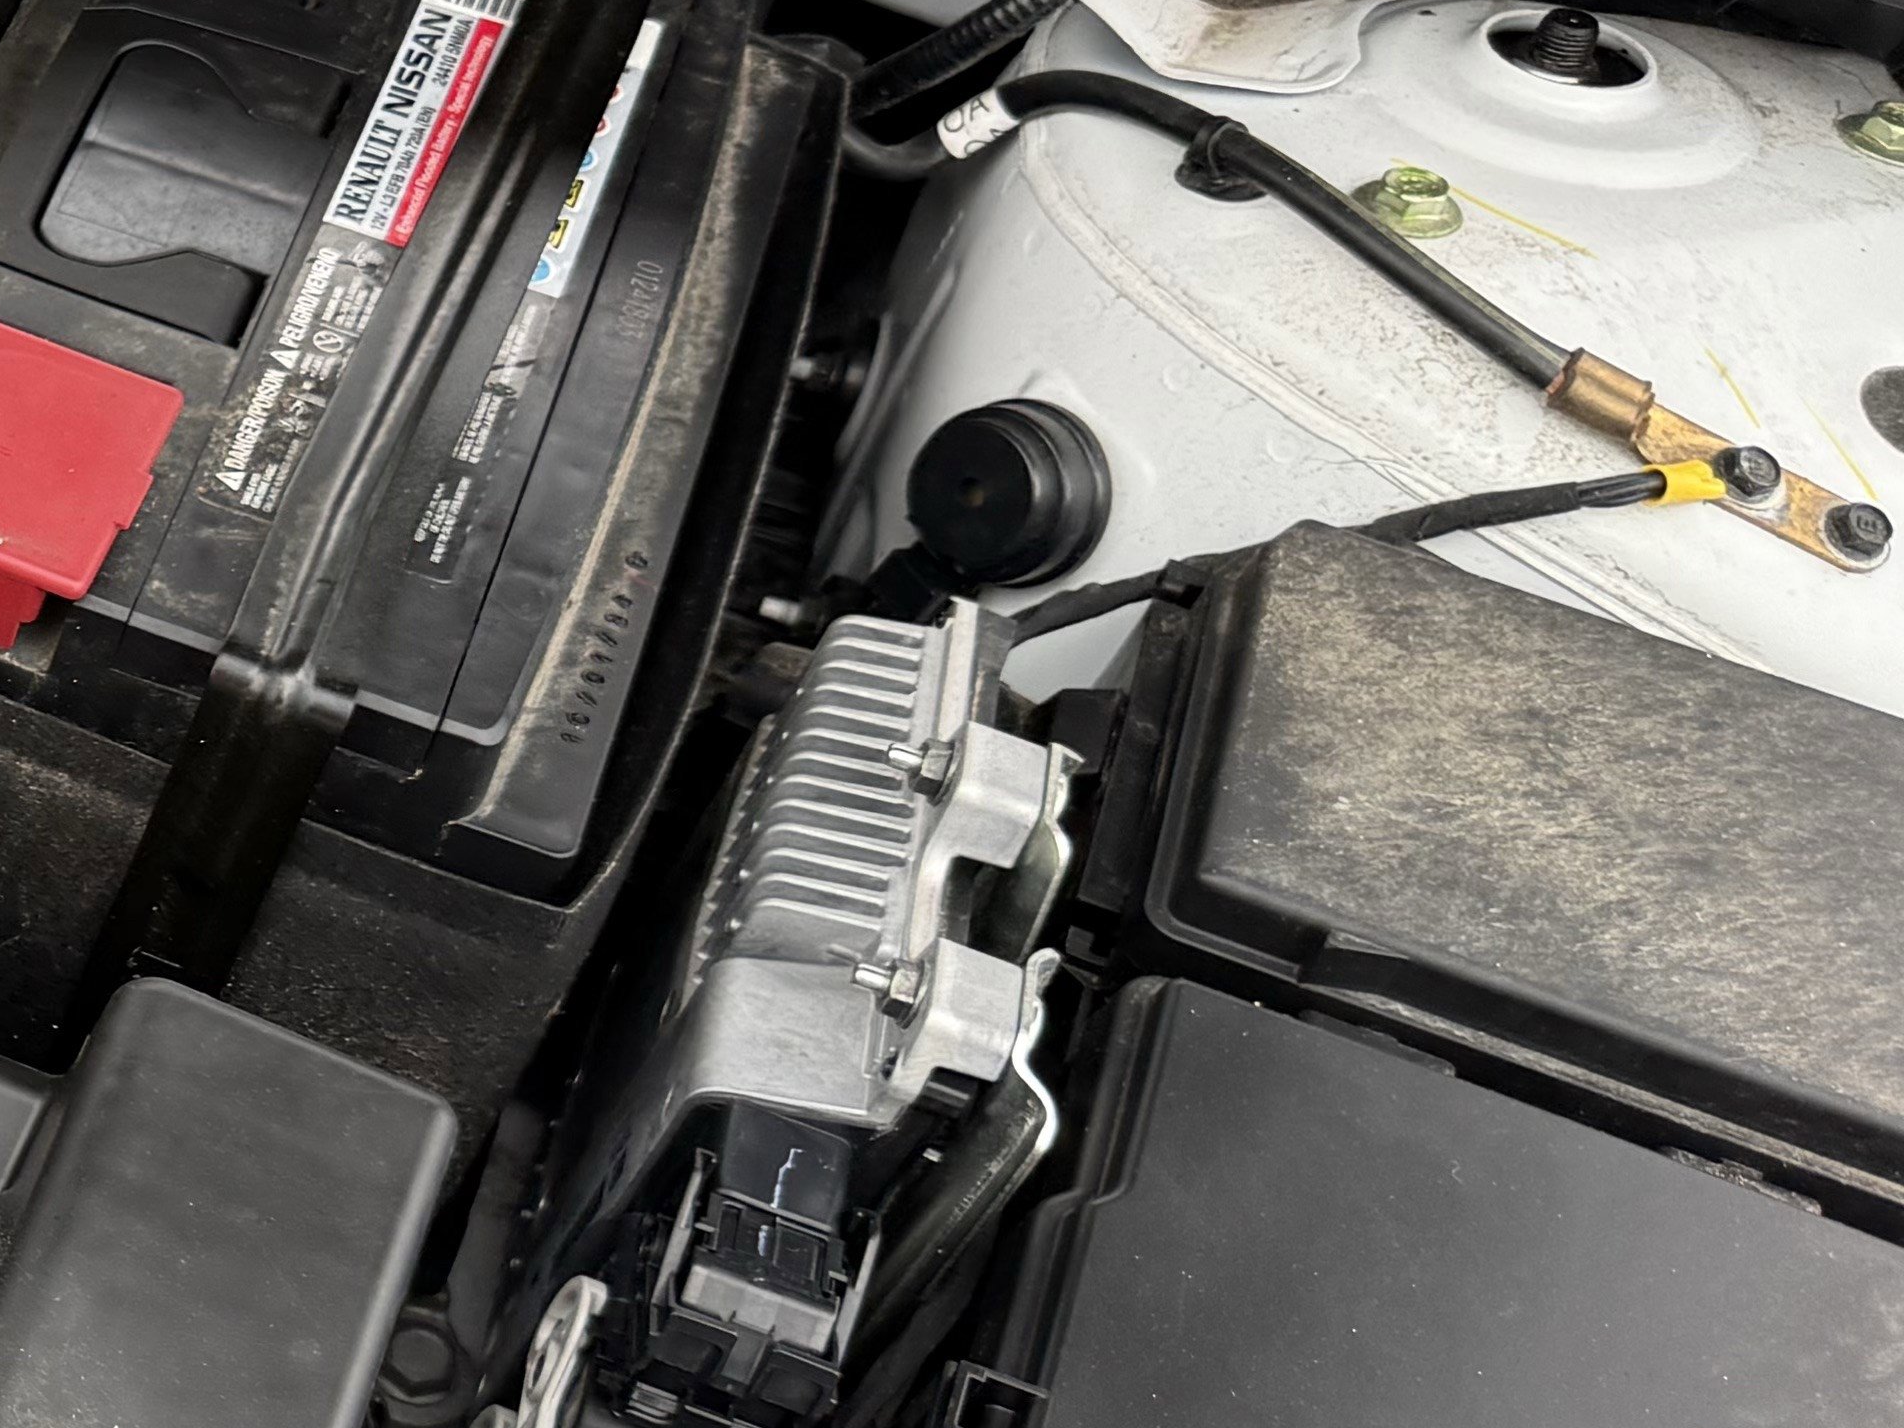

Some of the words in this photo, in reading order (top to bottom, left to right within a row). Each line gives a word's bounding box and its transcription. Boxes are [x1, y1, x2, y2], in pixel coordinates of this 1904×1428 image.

[334, 121, 402, 225] RENAULT
[382, 8, 452, 119] NISSAN
[369, 213, 389, 231] 12V
[385, 173, 405, 194] EFB
[224, 368, 288, 469] DANGER/POISON
